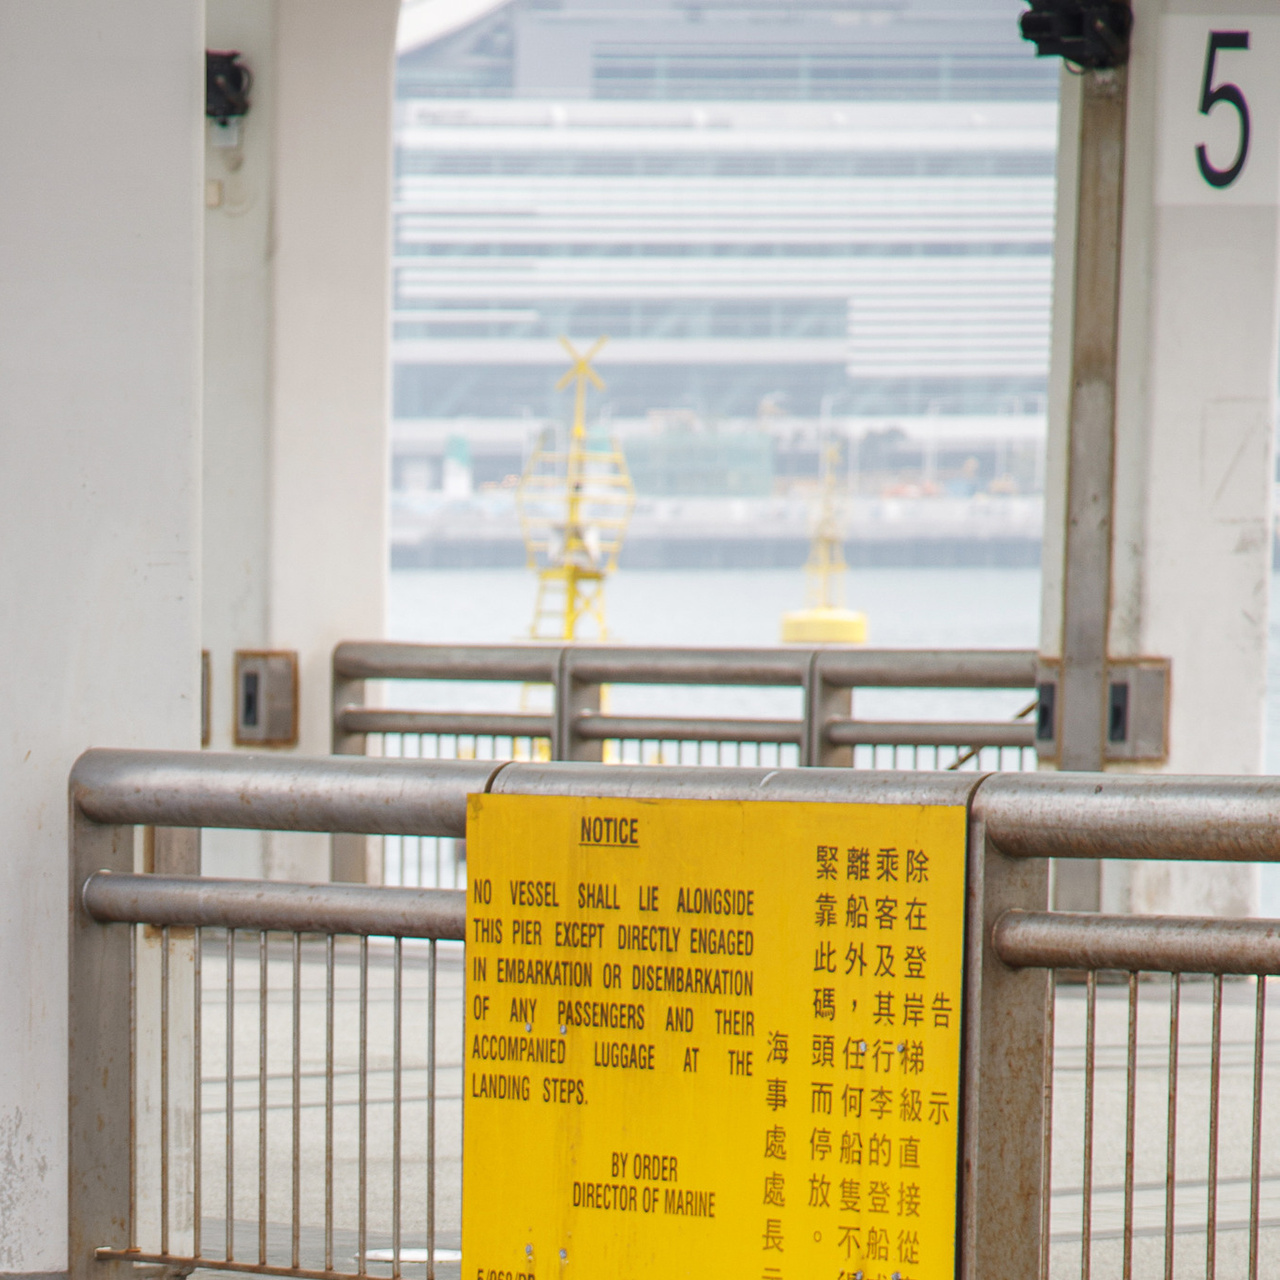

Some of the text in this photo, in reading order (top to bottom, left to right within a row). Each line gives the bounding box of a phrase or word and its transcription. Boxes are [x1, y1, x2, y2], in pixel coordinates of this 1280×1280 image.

[1196, 30, 1250, 189] 5
[580, 816, 639, 844] NOTICE
[473, 878, 755, 917] NO VESSEL SHALL LIE ALONGSIDE
[472, 917, 754, 957] THIS PIER EXCEPT DIRECTLY ENGAGED
[472, 956, 754, 998] IN EMBARKATION OR DISEMBARKATION
[473, 994, 755, 1038] OF ANY PASSENGERS AND THEIR
[471, 1032, 753, 1077] ACCOMPANIED LUGGAGE AT THE
[928, 992, 952, 1125] 告示
[471, 1073, 588, 1106] LANDING STEPS.
[611, 1151, 678, 1183] BY ORDER
[572, 1181, 716, 1219] DIRECTOR OF MARINE
